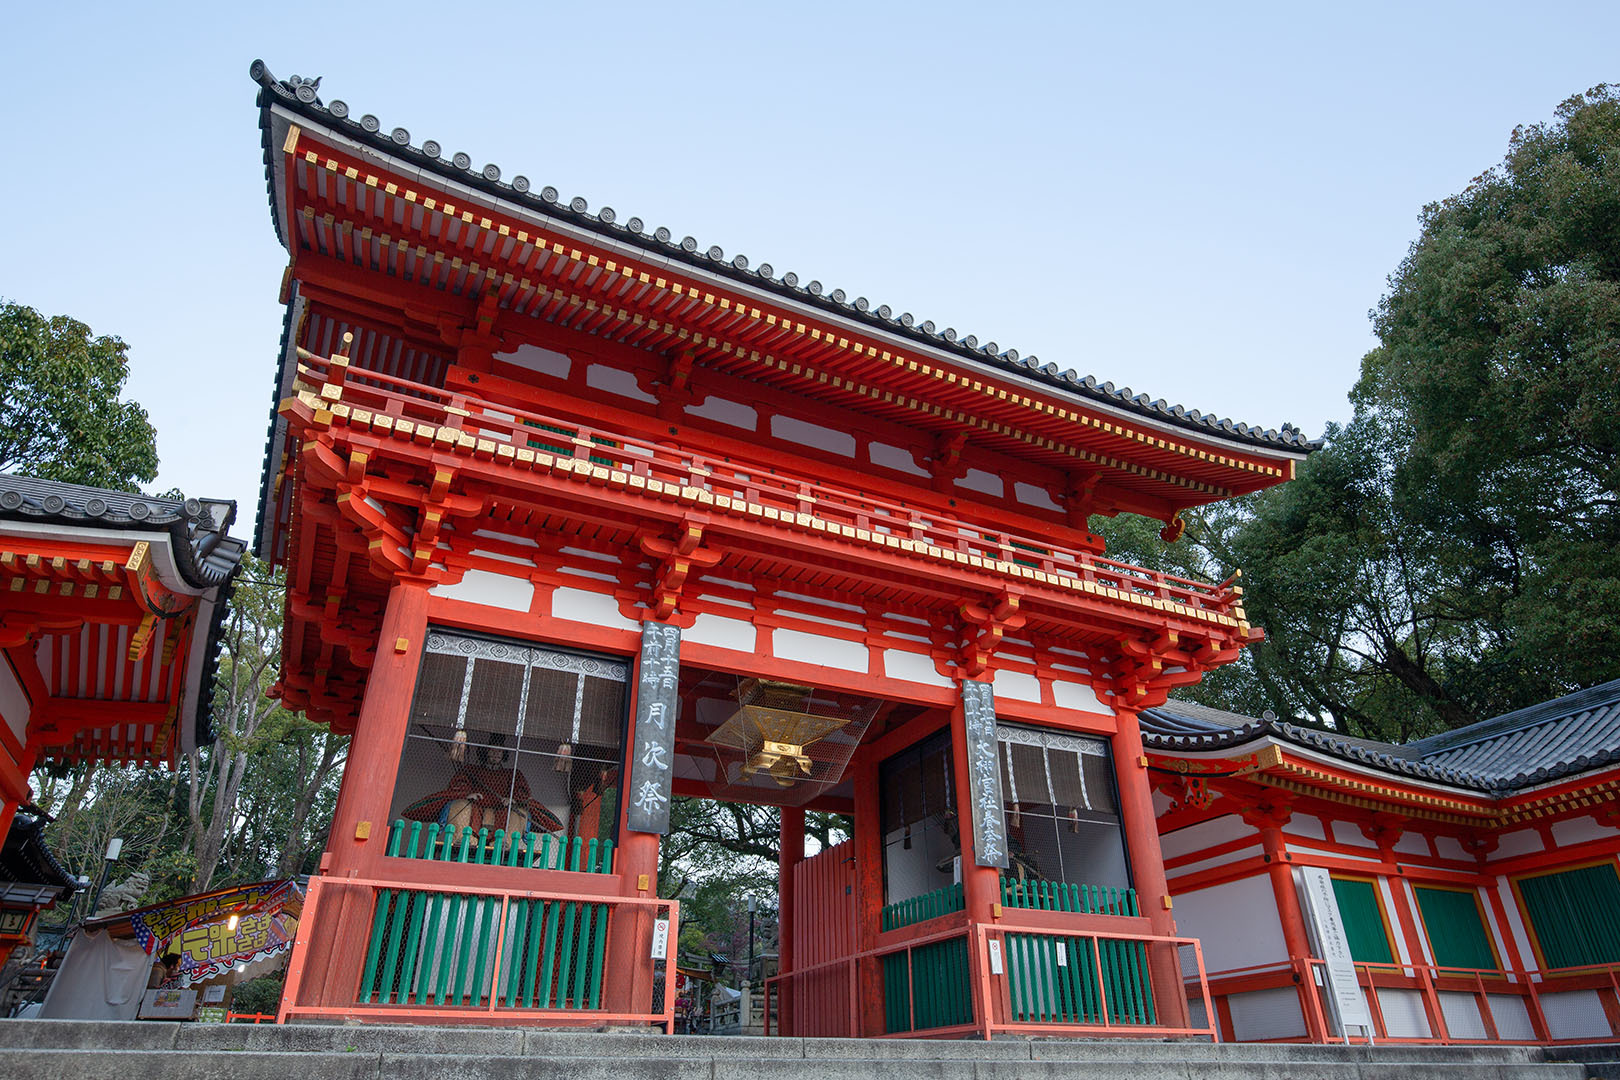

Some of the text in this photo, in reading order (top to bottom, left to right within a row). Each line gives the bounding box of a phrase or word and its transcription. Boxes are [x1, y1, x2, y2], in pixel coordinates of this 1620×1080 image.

[642, 622, 663, 690] 午前十時
[658, 627, 680, 690] 四月十五日
[634, 702, 669, 815] 月次祭
